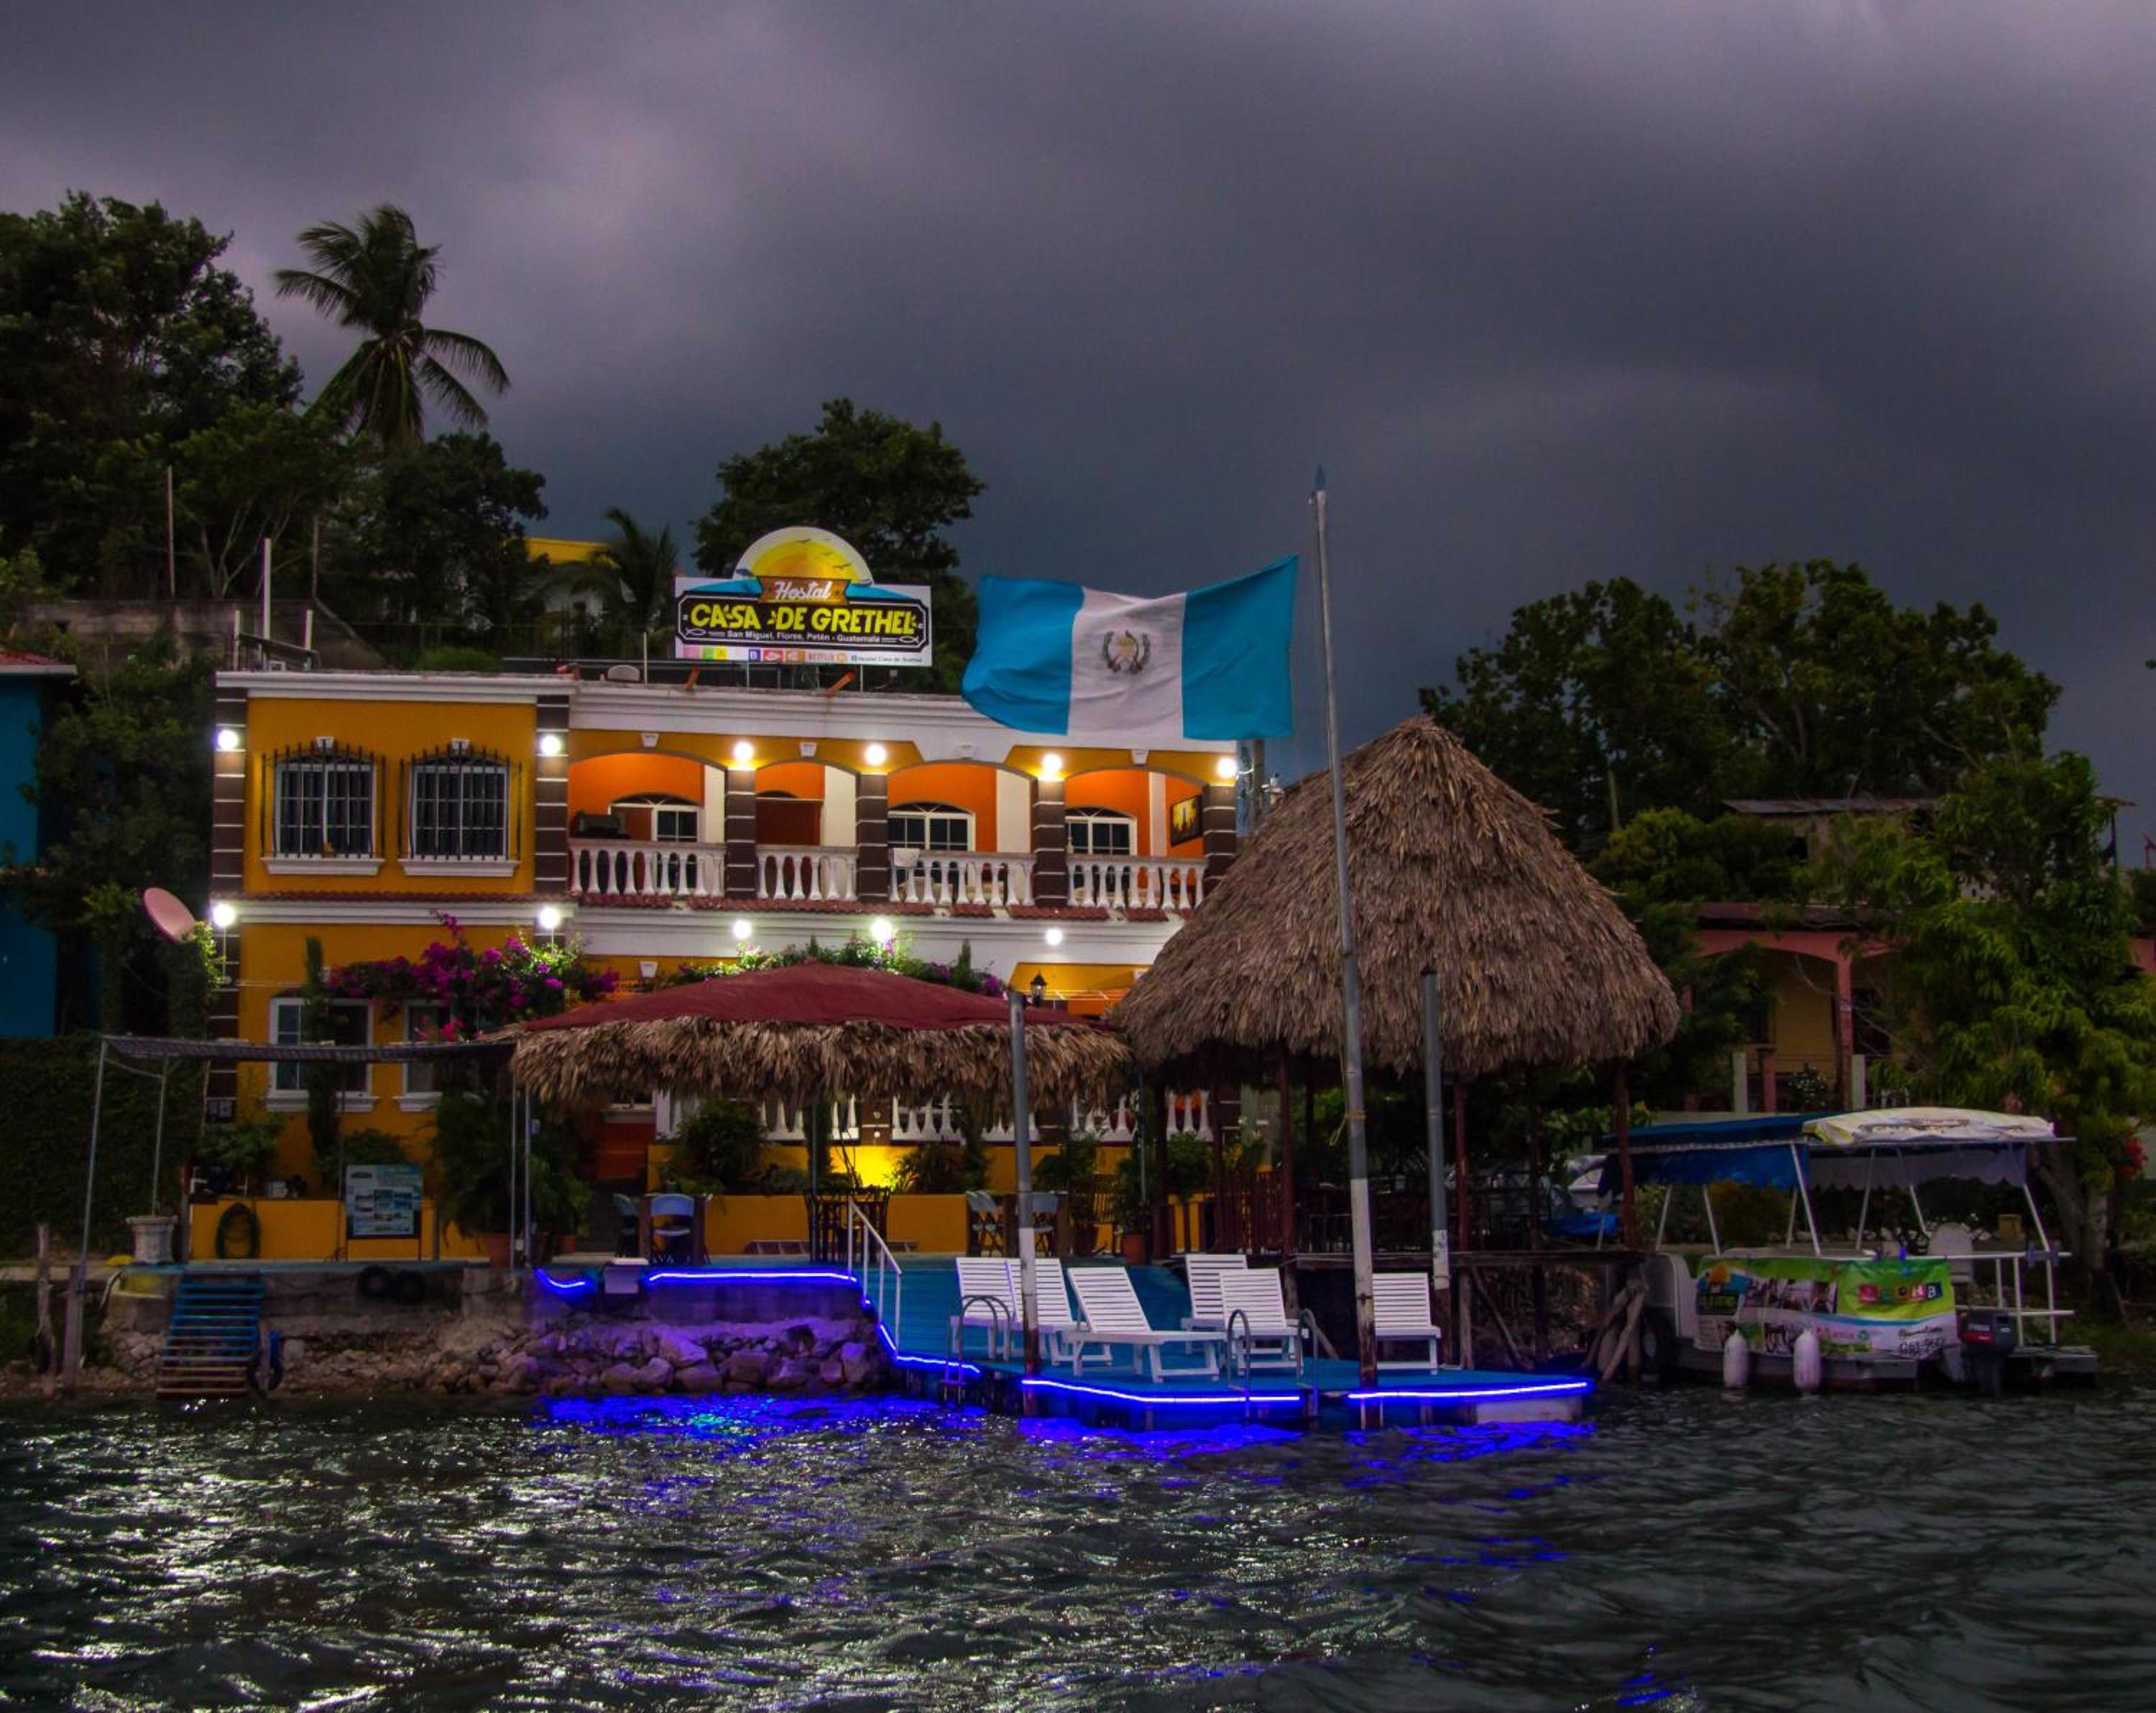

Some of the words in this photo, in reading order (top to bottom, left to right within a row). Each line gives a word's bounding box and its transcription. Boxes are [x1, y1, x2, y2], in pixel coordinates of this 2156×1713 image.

[774, 581, 831, 599] Hostal
[691, 604, 760, 629] CASA
[775, 607, 806, 631] DE
[811, 608, 916, 634] GRETHEL
